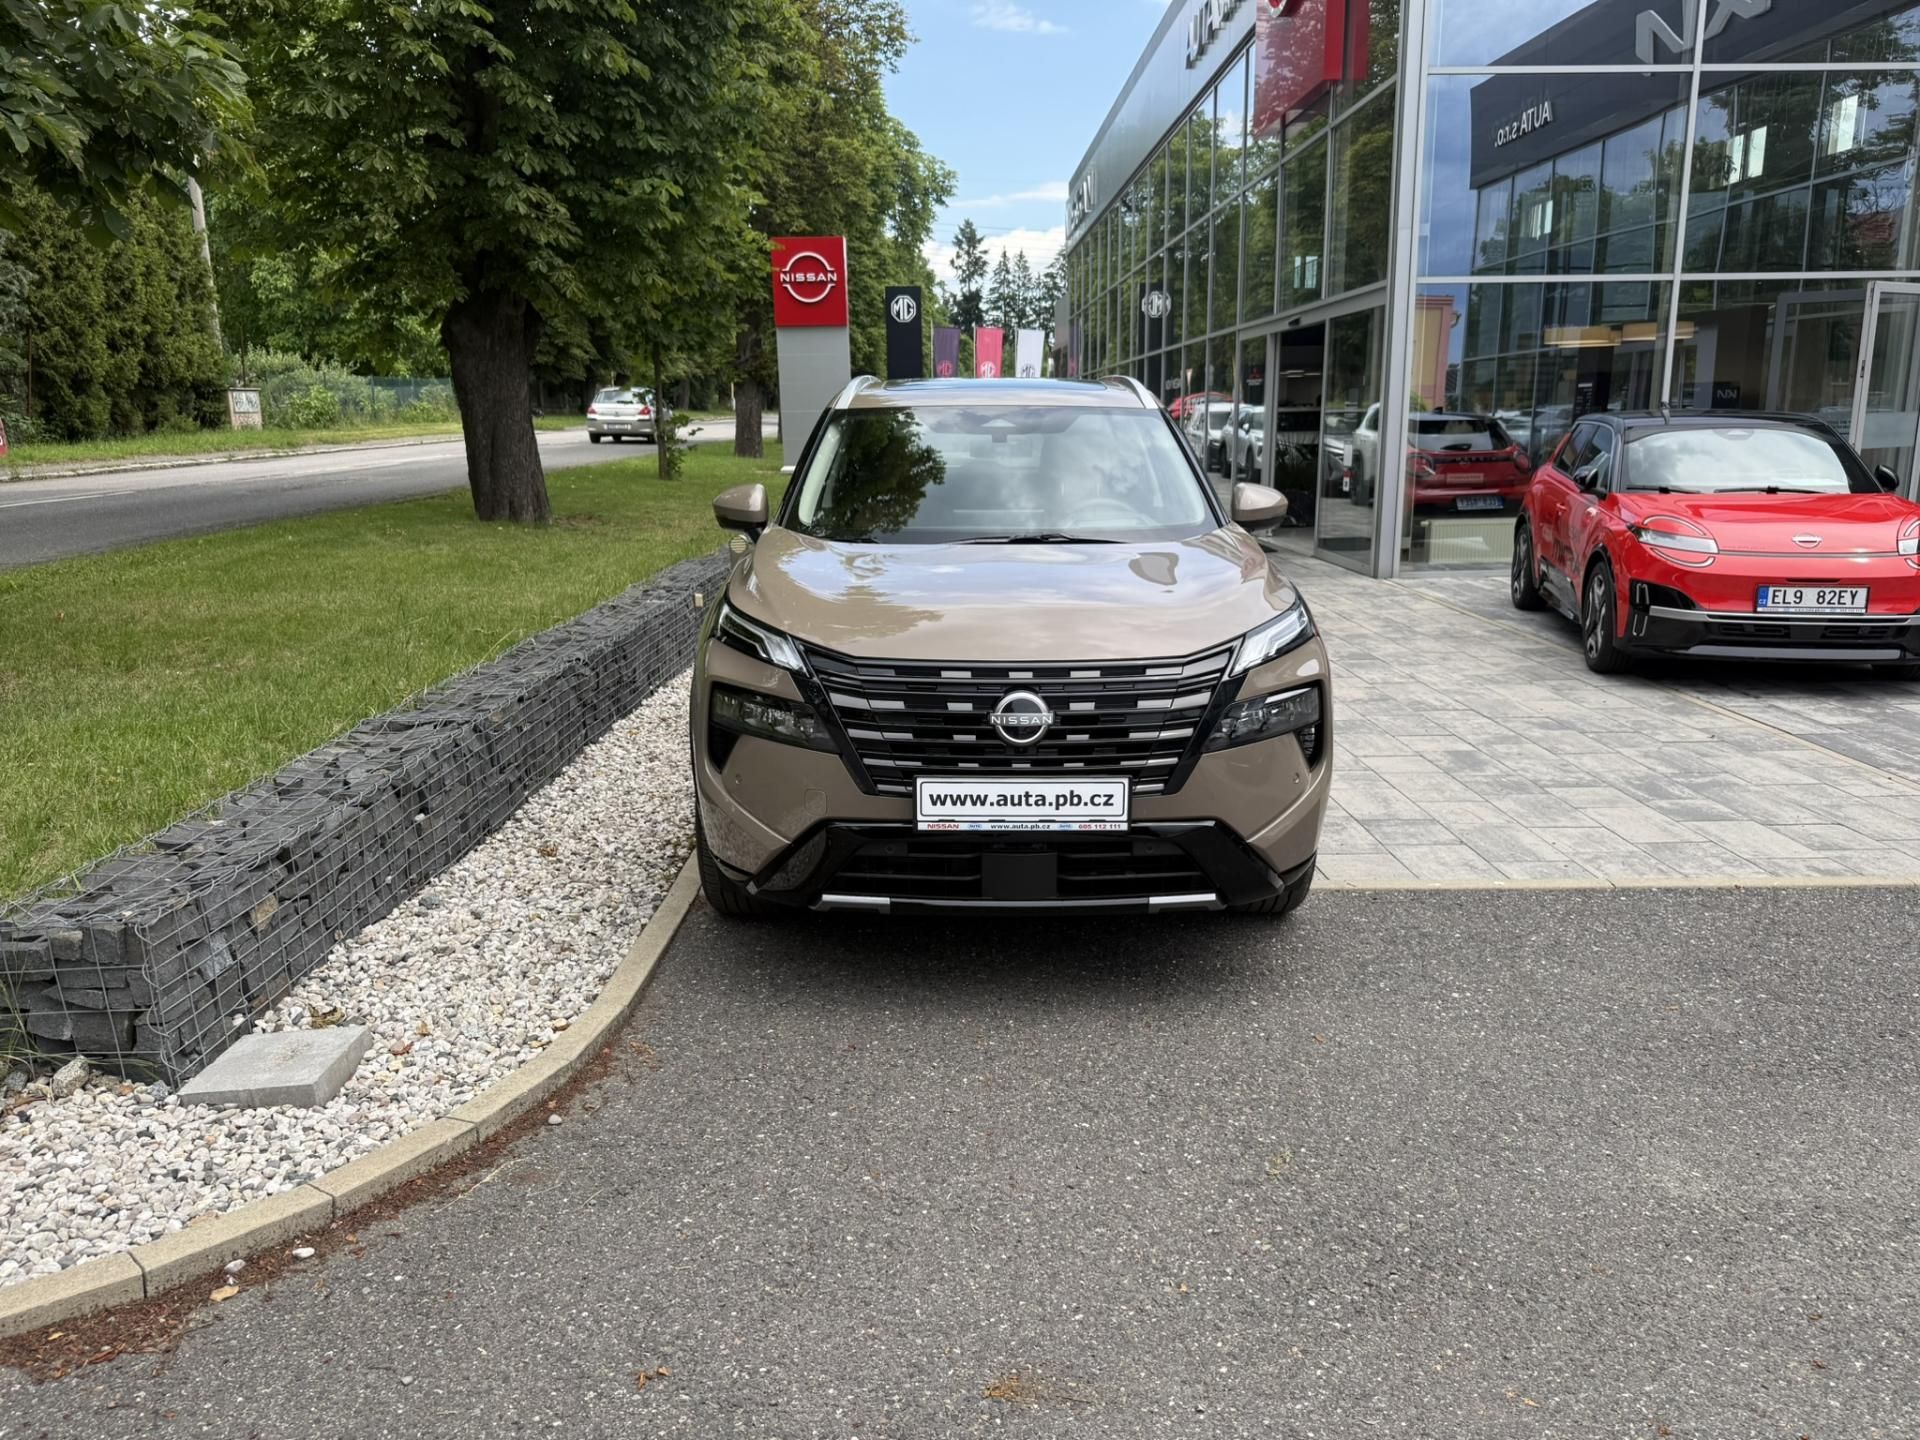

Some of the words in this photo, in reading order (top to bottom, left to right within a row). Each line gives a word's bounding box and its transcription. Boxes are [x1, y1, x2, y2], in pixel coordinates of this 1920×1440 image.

[780, 271, 838, 283] NISSAN
[893, 297, 915, 321] MG
[1771, 589, 1804, 605] EL9
[1815, 589, 1859, 606] 82EY
[991, 715, 1053, 725] NISSAN
[928, 789, 1115, 811] www.auta.pb.cz
[990, 823, 1051, 831] www.auta.pb.cz
